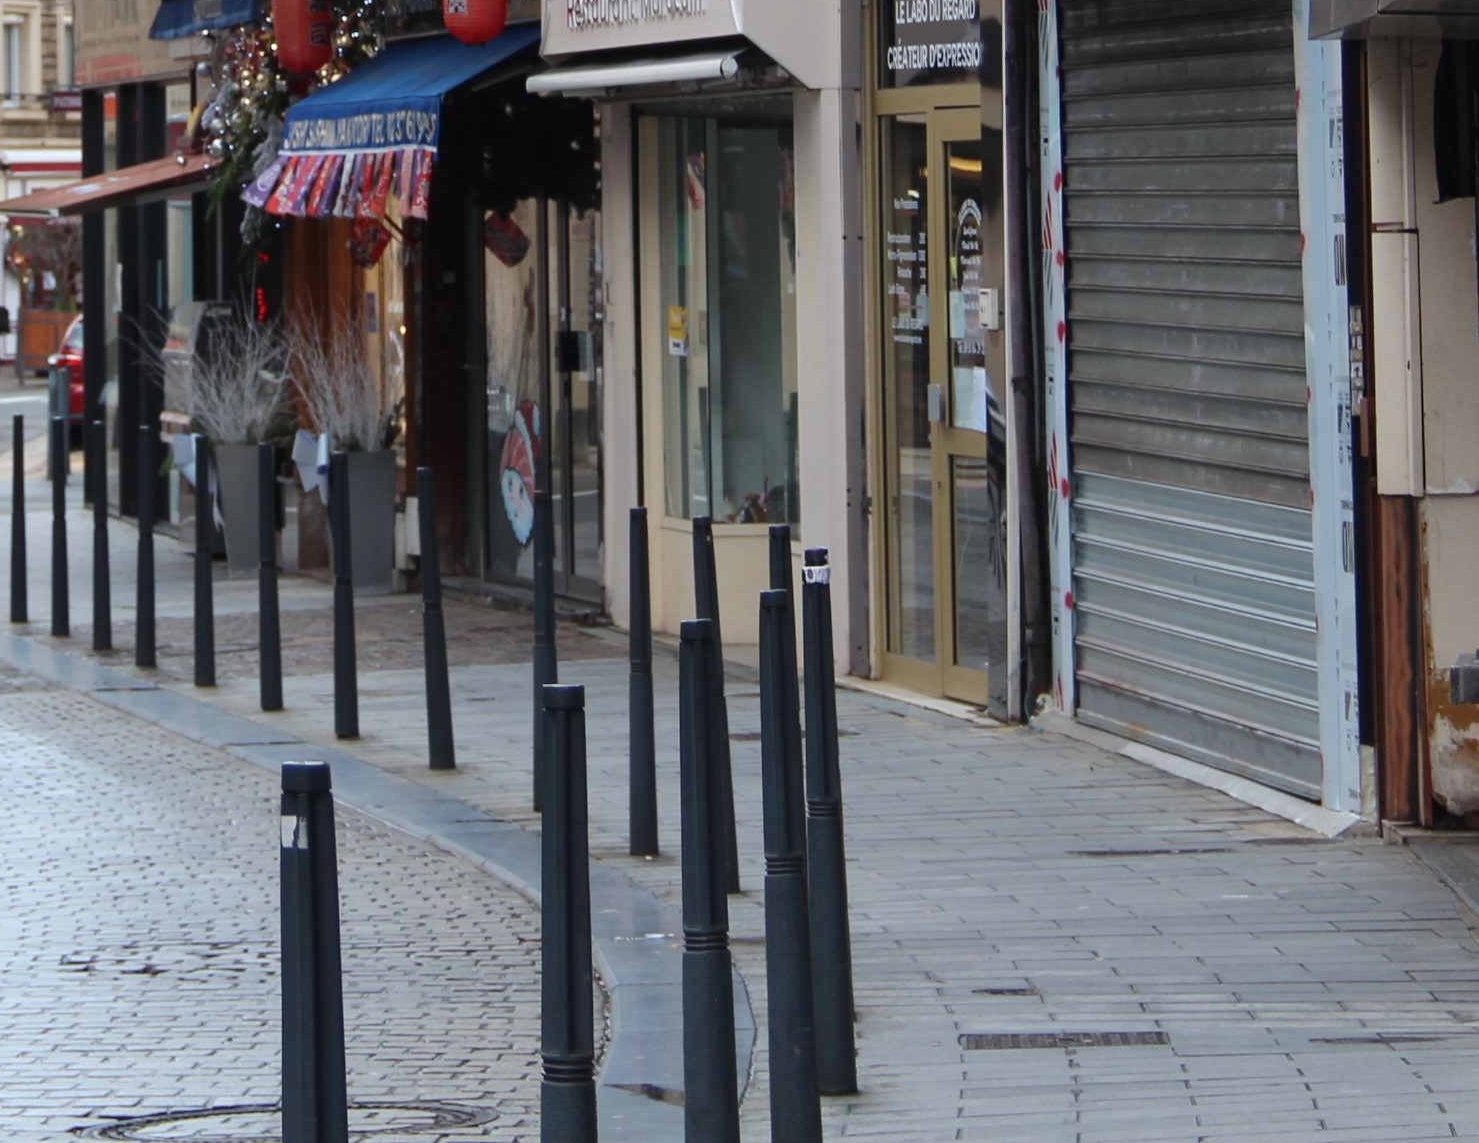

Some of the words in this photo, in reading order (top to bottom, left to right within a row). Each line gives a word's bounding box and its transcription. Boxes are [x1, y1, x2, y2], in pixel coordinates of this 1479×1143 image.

[895, 0, 905, 25] LE
[887, 37, 928, 70] CRÉATEUR
[929, 42, 981, 68] D'EXPRESSIO
